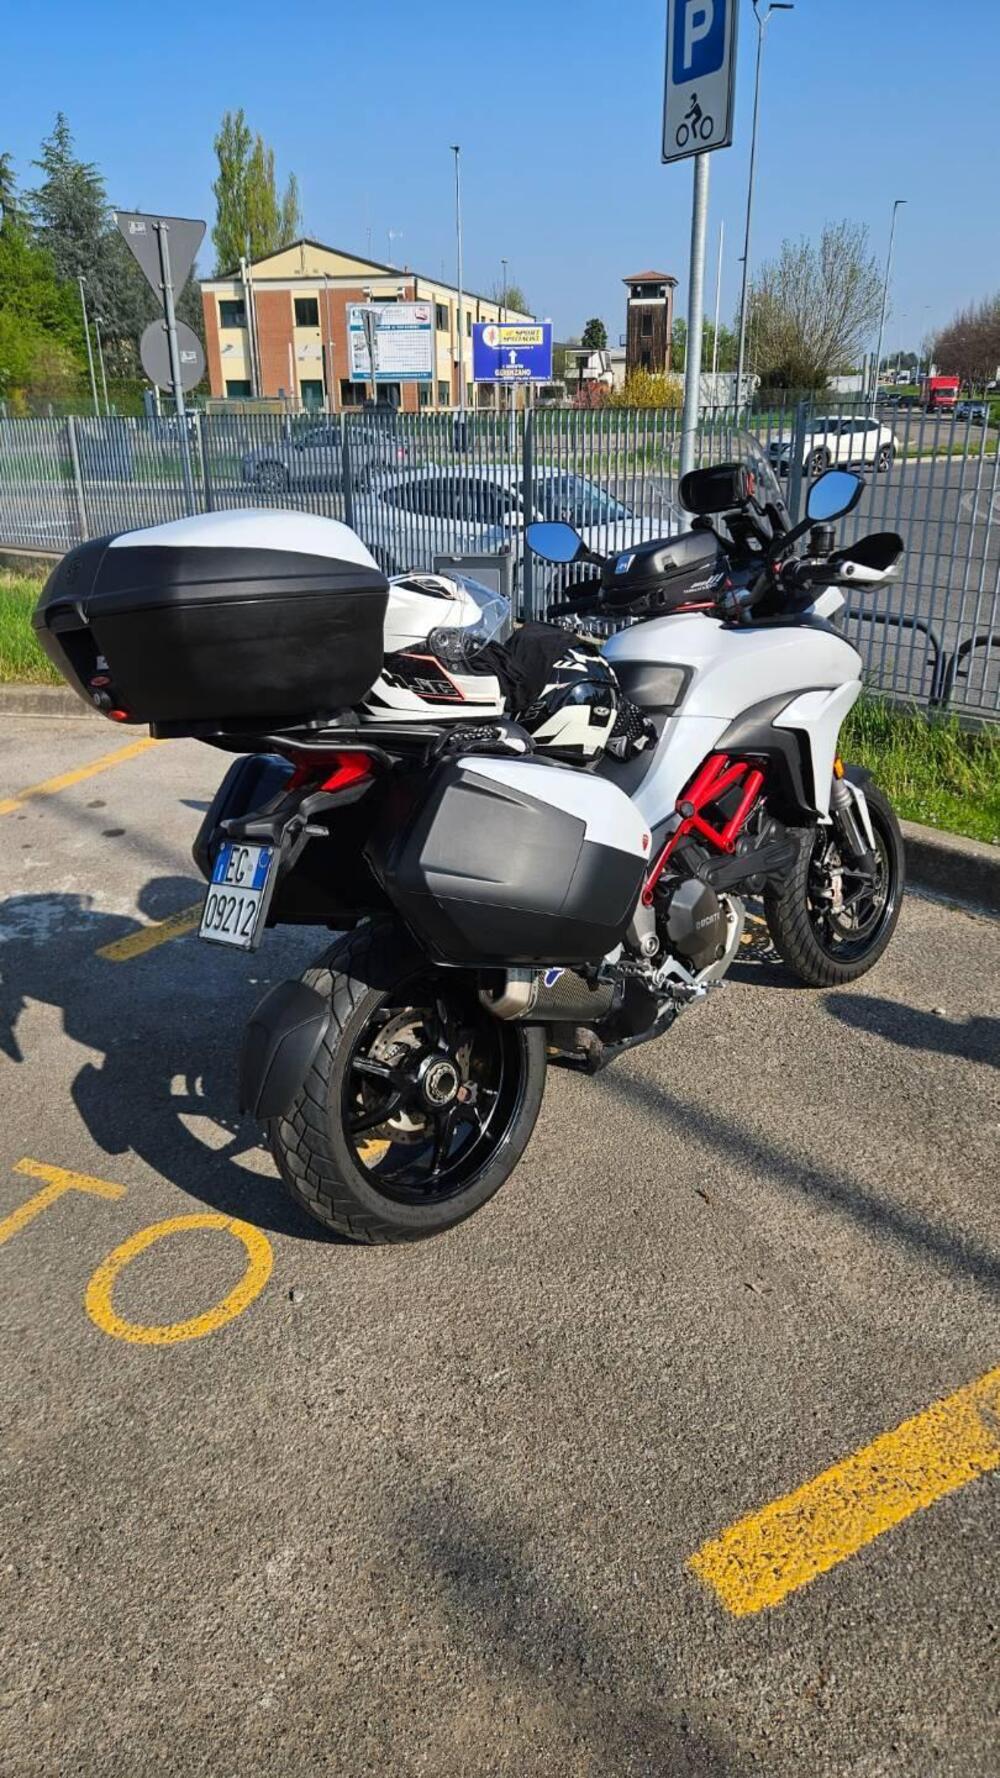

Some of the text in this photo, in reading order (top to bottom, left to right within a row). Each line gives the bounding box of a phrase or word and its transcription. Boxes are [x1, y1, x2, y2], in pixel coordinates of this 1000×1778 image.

[684, 0, 714, 69] P
[226, 847, 248, 883] EC
[205, 893, 256, 936] 09212
